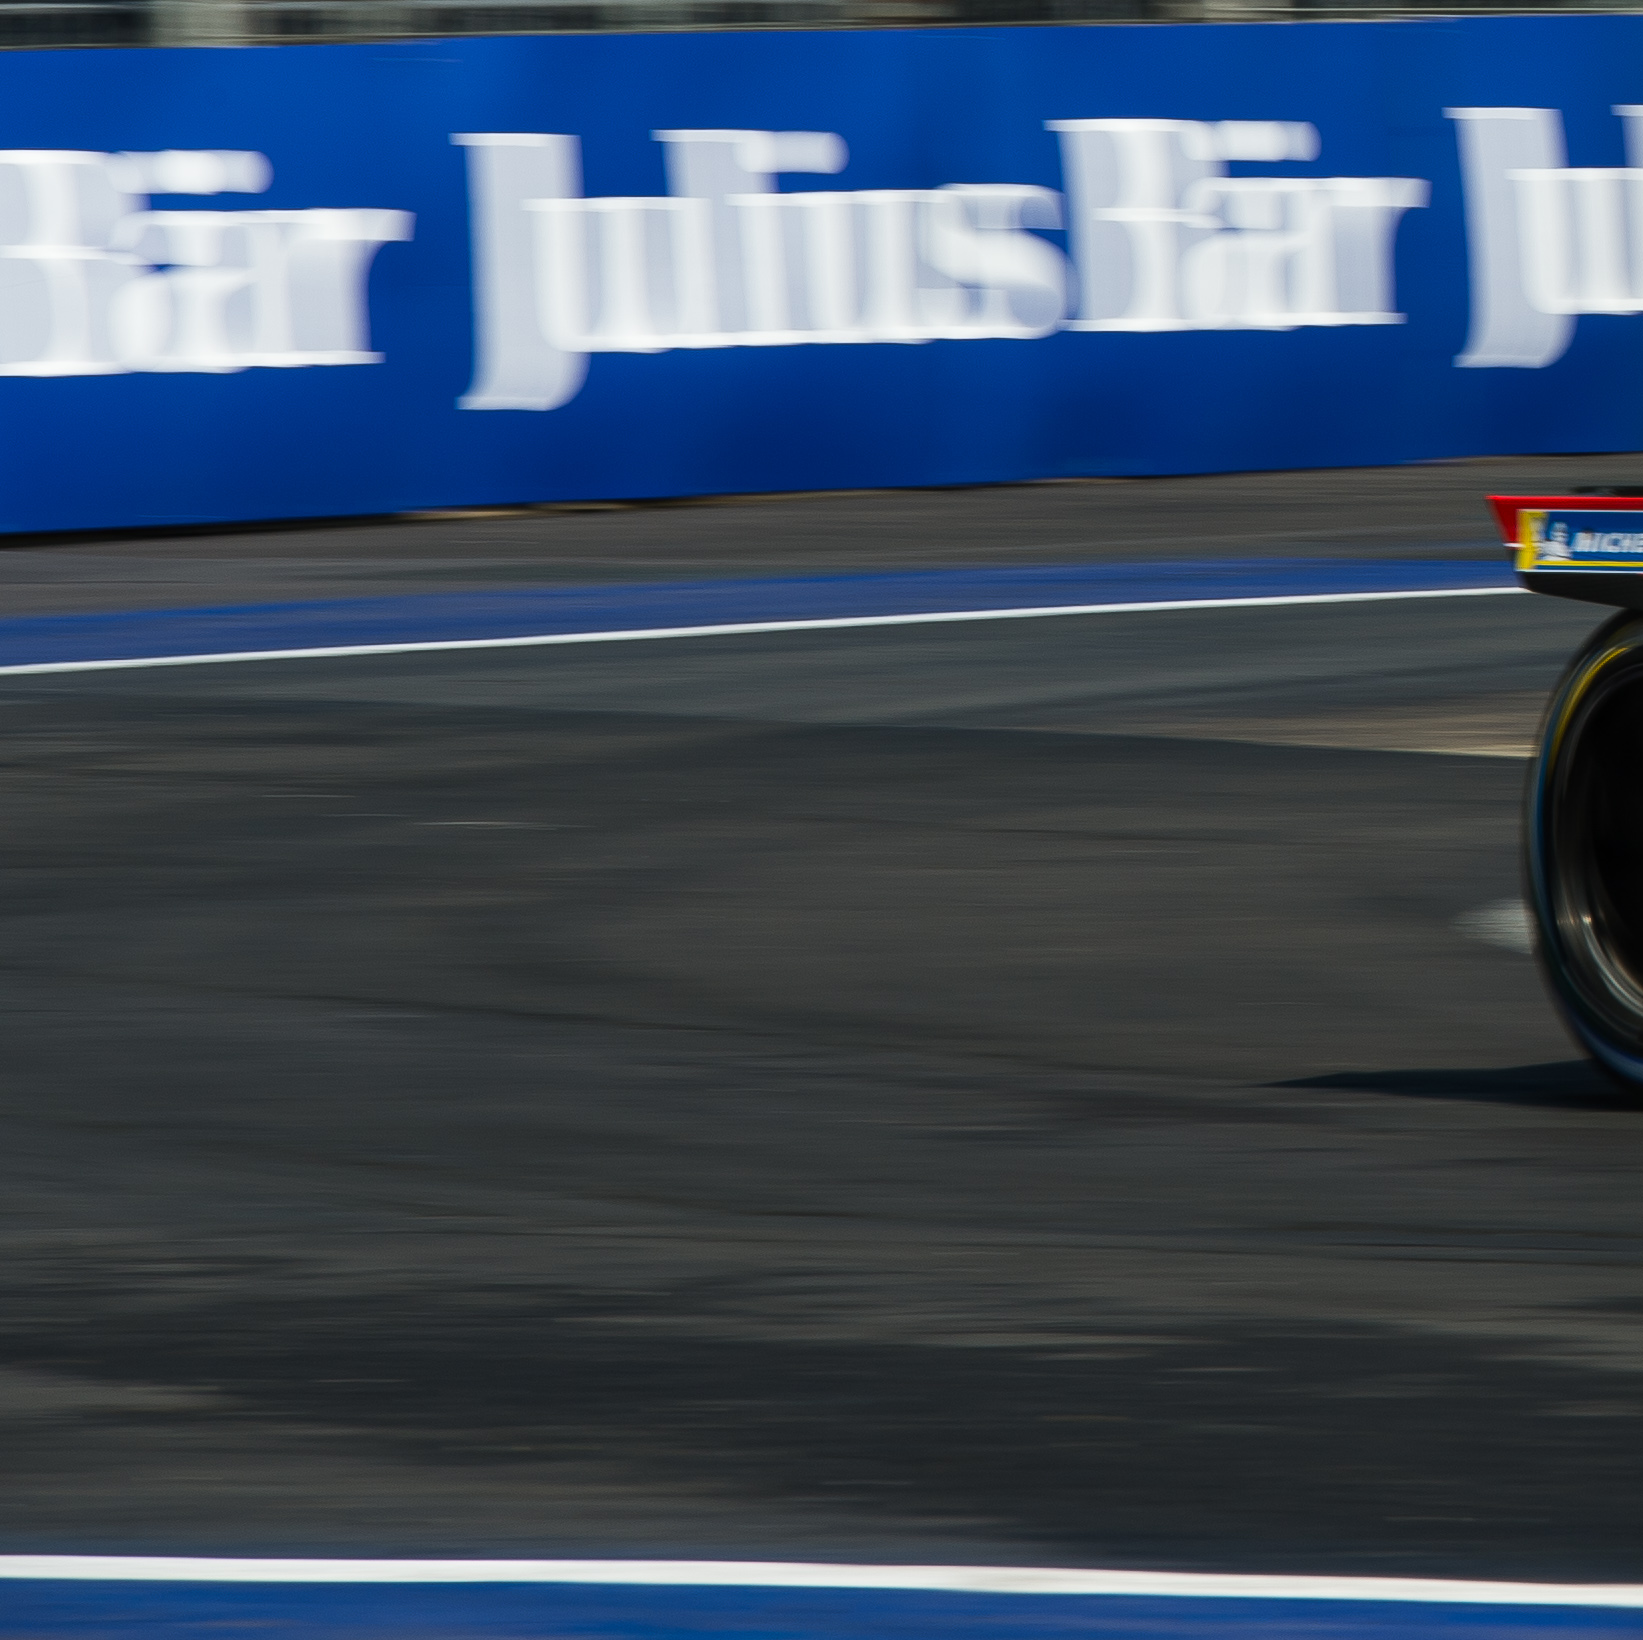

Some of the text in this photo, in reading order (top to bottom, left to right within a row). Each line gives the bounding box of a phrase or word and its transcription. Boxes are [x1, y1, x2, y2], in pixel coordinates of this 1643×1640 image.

[0, 149, 414, 377] Bär
[449, 118, 1431, 411] Julius Bär
